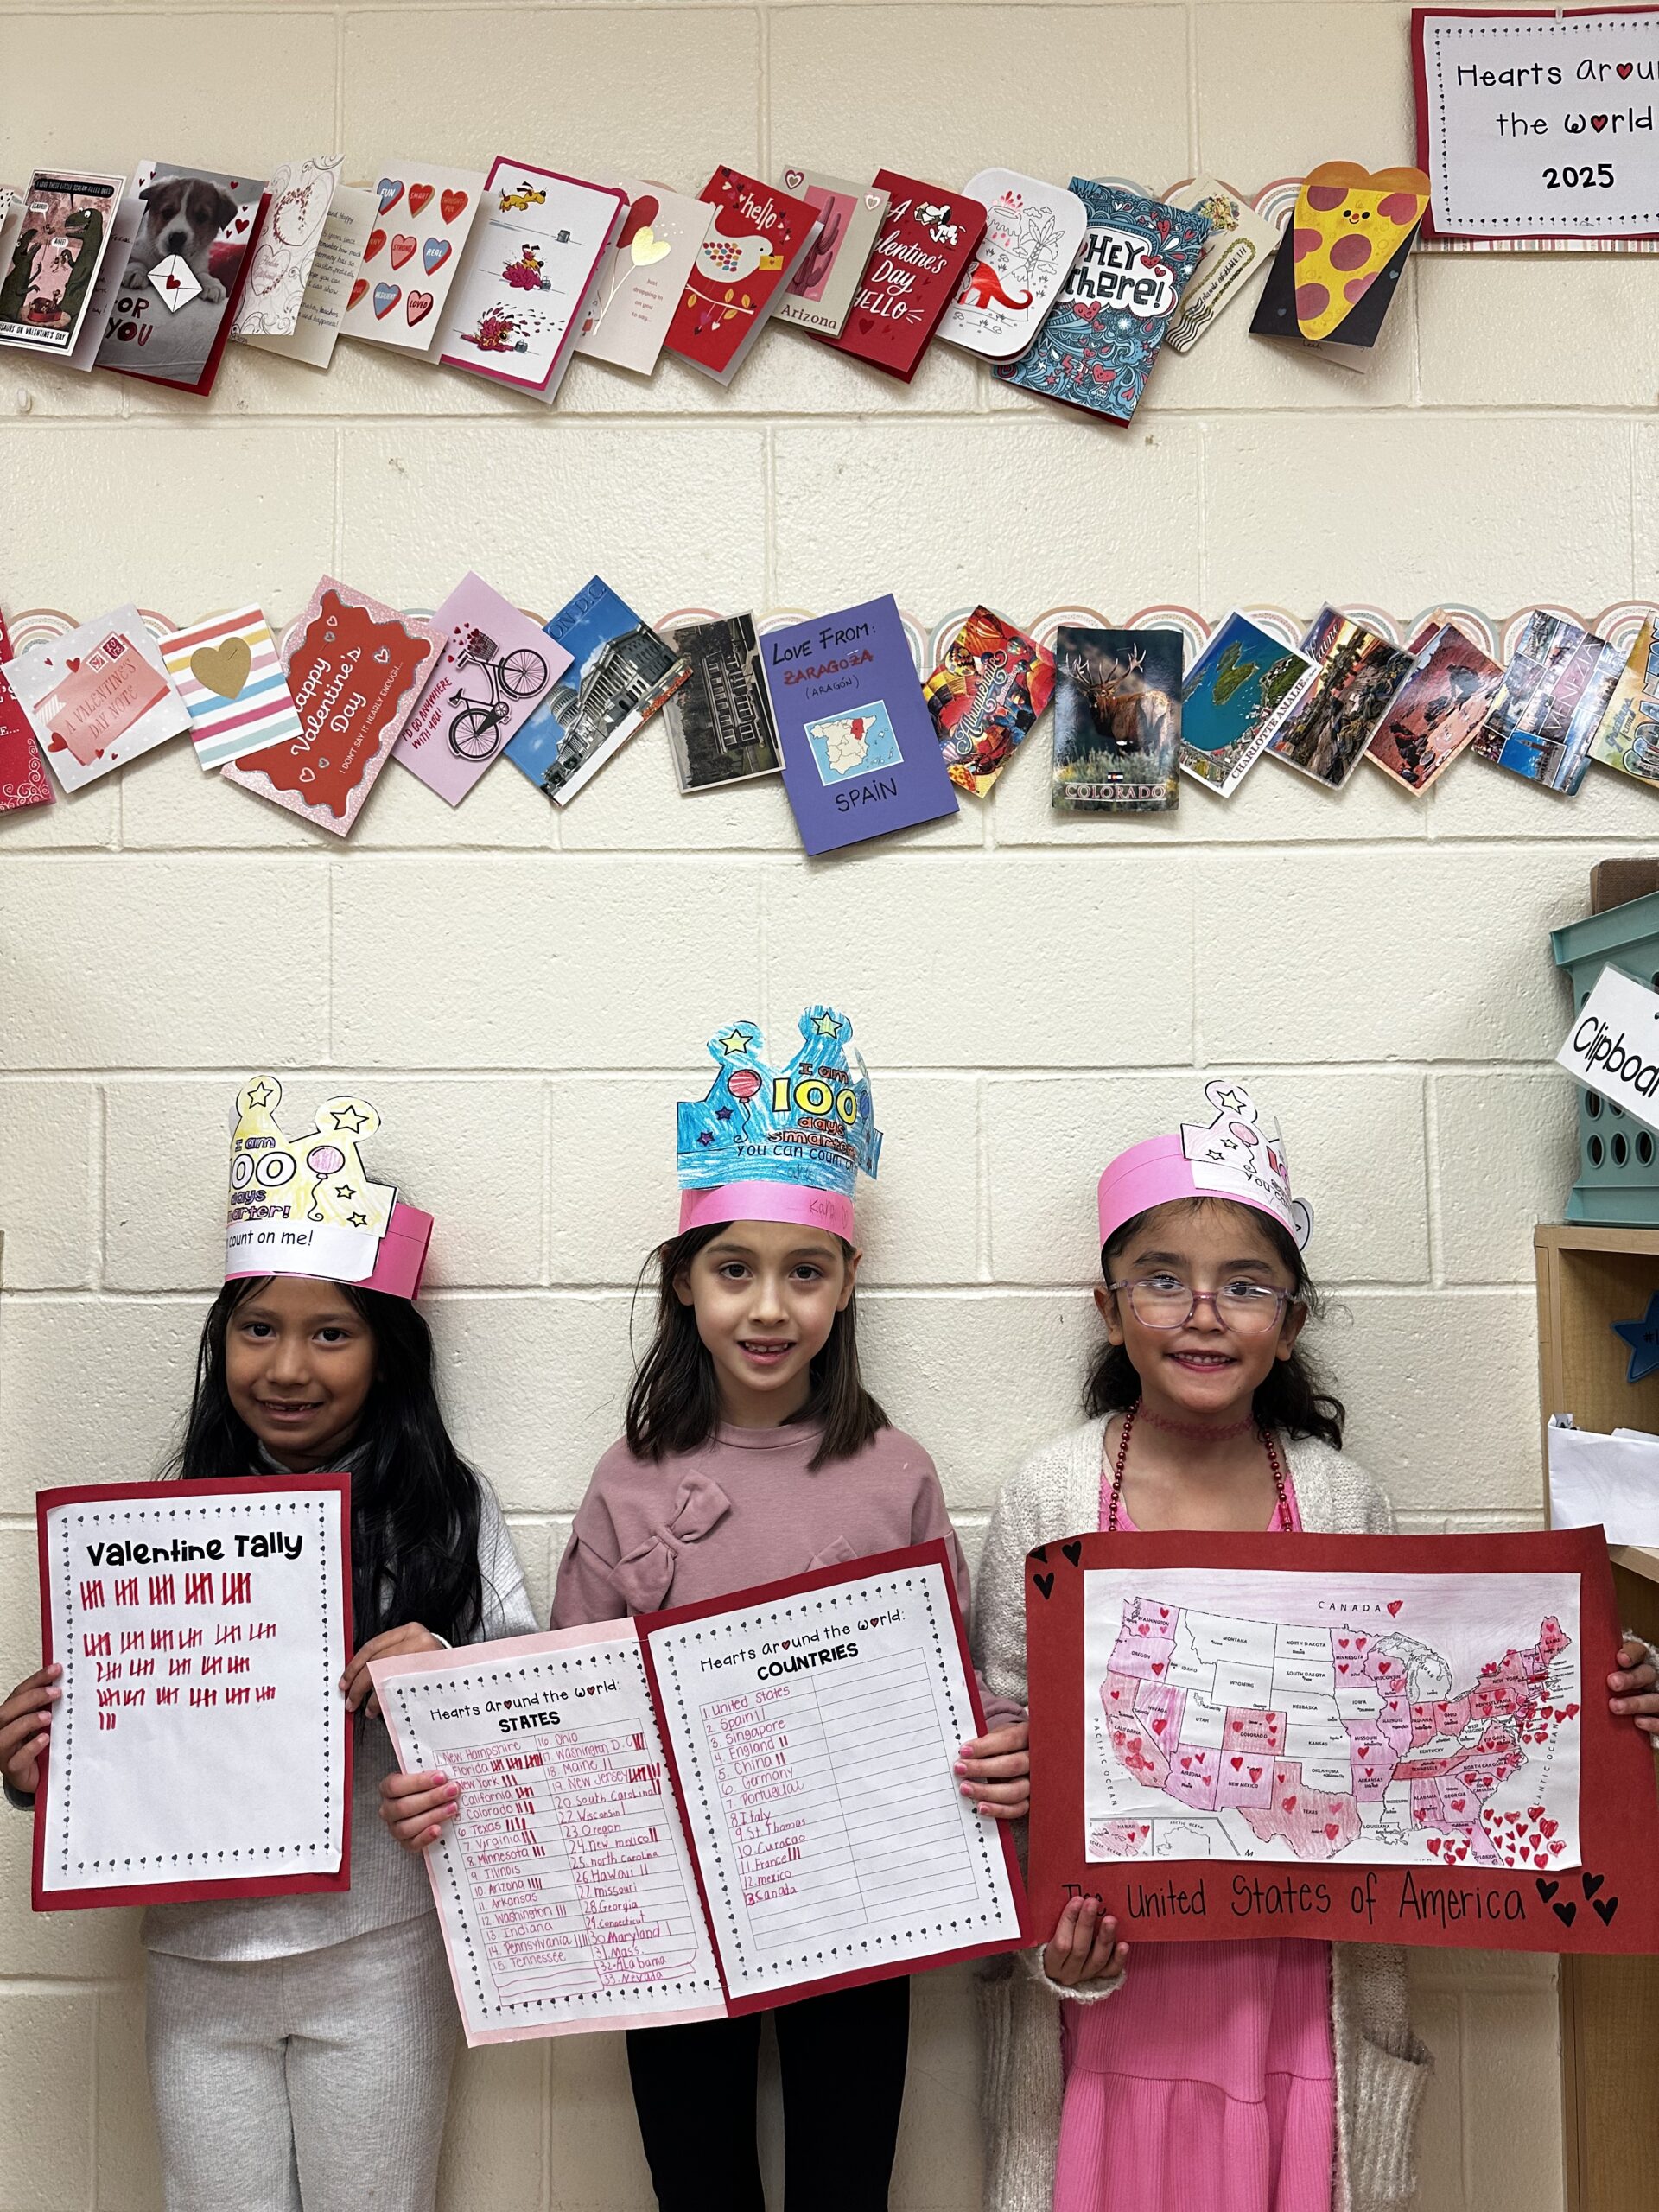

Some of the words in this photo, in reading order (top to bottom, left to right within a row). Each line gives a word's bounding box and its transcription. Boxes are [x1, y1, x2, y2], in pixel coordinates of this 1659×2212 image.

[1457, 62, 1562, 87] Hearts
[1496, 111, 1549, 137] the
[1541, 163, 1615, 189] 2025
[380, 188, 396, 198] FUN
[410, 191, 429, 200] SMART
[741, 193, 777, 230] hello
[887, 199, 912, 223] A
[392, 244, 412, 253] STRONG
[427, 248, 442, 257] REAL
[1084, 233, 1145, 270] HEY
[871, 259, 913, 296] Day
[115, 296, 149, 319] OR
[410, 299, 429, 309] LOVED
[780, 304, 837, 329] Arizona
[105, 316, 154, 346] YOU
[772, 639, 812, 665] LOVE
[784, 649, 874, 685] ZARAGOZA
[295, 658, 331, 713] appy
[65, 720, 76, 734] A
[73, 658, 137, 728] VALENTINE'S
[290, 646, 361, 756] Valentine's
[88, 715, 111, 739] DAY
[109, 684, 139, 720] NOTE
[330, 691, 366, 733] Day
[403, 729, 412, 742] I'D
[411, 717, 422, 733] GO
[422, 677, 453, 720] ANYWHERE
[354, 733, 366, 752] SAY
[366, 696, 384, 726] NEARLY
[412, 731, 431, 750] WITH
[429, 707, 443, 735] YOU!
[1231, 717, 1279, 779] CHARLOTTE
[1277, 679, 1306, 719] AMALIE
[1065, 785, 1166, 800] COLORADO
[799, 1063, 812, 1075] I
[817, 1066, 849, 1084] am
[772, 1078, 857, 1125] 100
[797, 1116, 845, 1137] days
[245, 1136, 276, 1149] am
[737, 1144, 766, 1158] you
[773, 1144, 804, 1158] can
[229, 1151, 297, 1192] 00
[230, 1189, 267, 1205] days
[229, 1230, 253, 1248] count
[257, 1230, 275, 1244] on
[281, 1230, 313, 1246] me!
[86, 1539, 225, 1567] Valentine
[234, 1531, 302, 1560] Tally
[1318, 1600, 1381, 1612] CANADA
[1138, 1616, 1170, 1626] WASHINGTON
[700, 1649, 757, 1673] Hearts
[762, 1630, 821, 1656] around
[824, 1623, 852, 1639] the
[1131, 1650, 1151, 1659] OREGON
[757, 1643, 860, 1681] COUNTRIES
[430, 1704, 480, 1721] Hearts
[485, 1692, 539, 1712] around
[543, 1689, 569, 1706] the
[712, 1695, 748, 1717] United
[755, 1685, 790, 1704] States
[1147, 1706, 1168, 1714] NEVADA
[499, 1711, 561, 1733] STATES
[726, 1718, 786, 1745] Singapore
[1115, 1725, 1141, 1735] CALIFORNIA
[555, 1732, 577, 1745] Ohio
[442, 1751, 463, 1764] New
[465, 1742, 521, 1761] Hampshire
[556, 1743, 609, 1759] Washington
[729, 1740, 775, 1761] England
[453, 1763, 489, 1777] Florida
[563, 1759, 598, 1775] Maine
[734, 1756, 772, 1775] China
[1180, 1770, 1202, 1778] ARIZONA
[477, 1777, 499, 1789] York
[568, 1776, 591, 1789] New
[741, 1767, 793, 1789] Germany
[461, 1790, 513, 1807] California
[575, 1792, 605, 1807] South
[467, 1804, 513, 1820] Colorado
[577, 1808, 620, 1822] Wisconsin
[470, 1821, 501, 1834] Texas
[582, 1823, 621, 1839] Oregon
[766, 1818, 806, 1837] Thomas
[475, 1834, 520, 1852] Virginia
[615, 1835, 650, 1848] mexico
[479, 1847, 531, 1865] Minnesota
[754, 1853, 787, 1872] France
[486, 1865, 521, 1879] Illinois
[591, 1868, 634, 1883] Hawaii
[489, 1880, 525, 1894] Arizona
[492, 1892, 537, 1909] Arkansas
[1127, 1878, 1206, 1918] United
[1232, 1875, 1331, 1916] States
[1351, 1872, 1377, 1924] of
[1400, 1870, 1526, 1929] America
[496, 1904, 553, 1926] Washington
[505, 1922, 553, 1938] Indiana
[607, 1921, 660, 1943] Maryland
[503, 1936, 572, 1956] Pennsylvania
[510, 1951, 567, 1968] Tennessee
